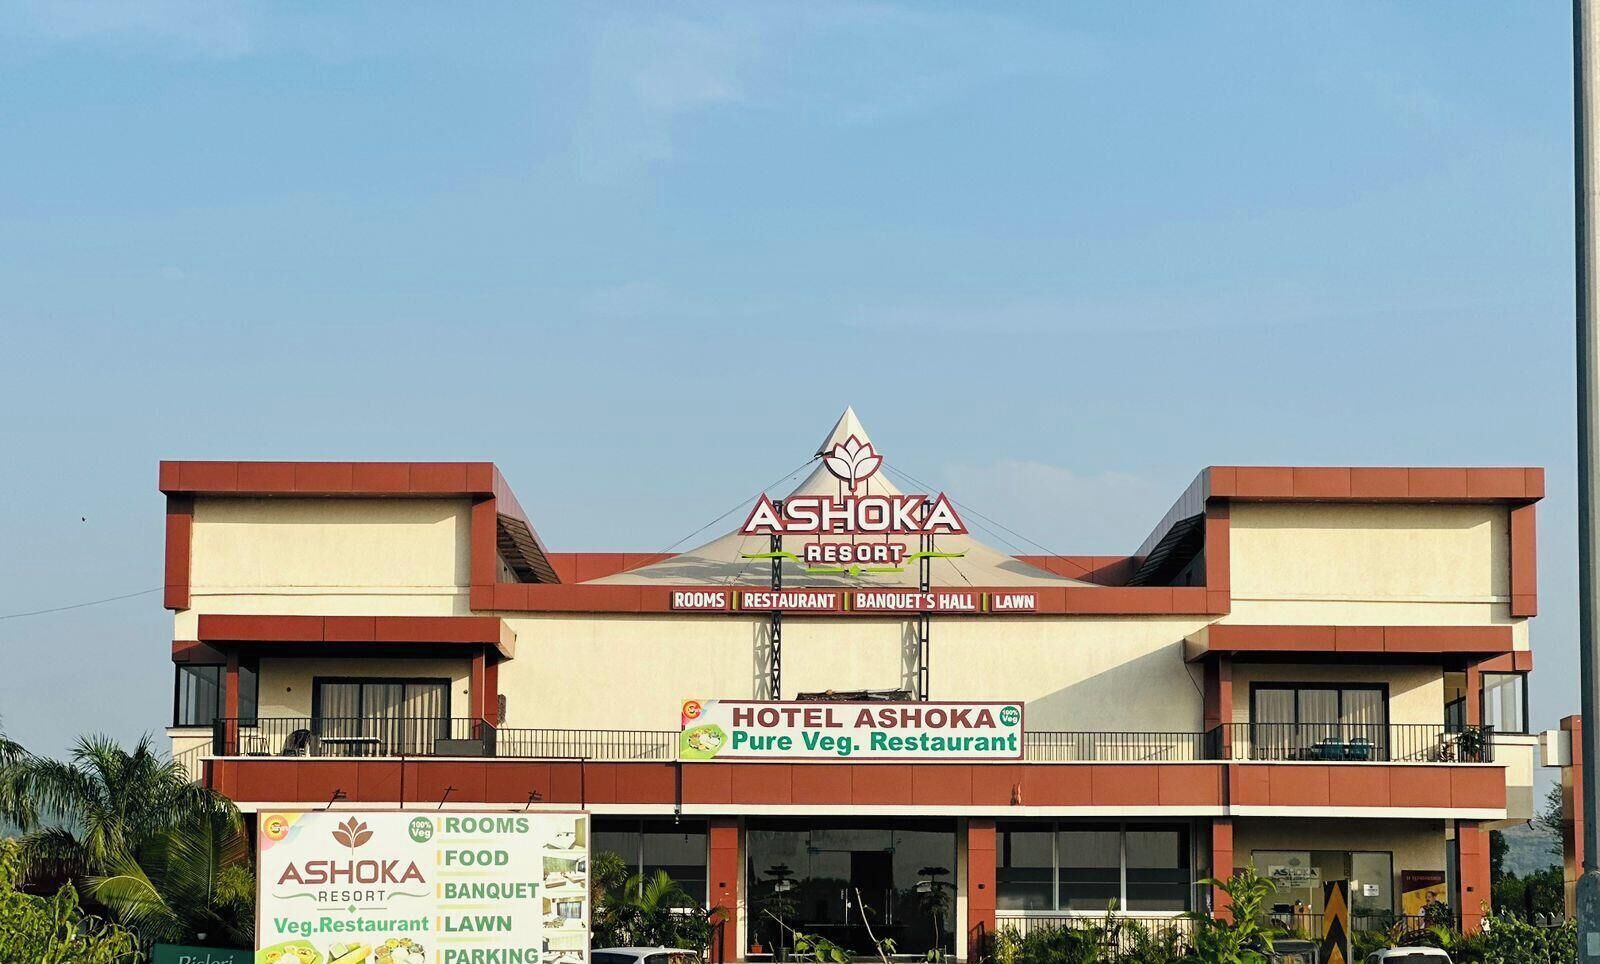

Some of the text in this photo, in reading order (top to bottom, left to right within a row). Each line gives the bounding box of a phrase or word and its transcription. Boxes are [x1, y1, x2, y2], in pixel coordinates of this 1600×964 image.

[740, 494, 966, 534] ASHOKA
[806, 544, 905, 563] RESORT
[674, 591, 725, 608] ROOMS
[744, 592, 836, 609] RESTAURANT
[856, 593, 975, 610] BANQUET'S HALL
[995, 594, 1035, 609] LAWN
[732, 707, 997, 729] HOTEL ASHOKA
[1002, 715, 1017, 724] Veg
[732, 731, 1017, 756] Pure Veg. Restaurant
[411, 821, 431, 829] 100%
[411, 828, 431, 839] Veg
[445, 817, 530, 833] ROOMS
[445, 850, 509, 866] FOOD
[277, 860, 426, 884] ASHOKA
[318, 890, 386, 902] RESORT
[445, 883, 539, 900] BANQUET
[445, 915, 512, 932] LAWN
[444, 948, 539, 964] PARKING
